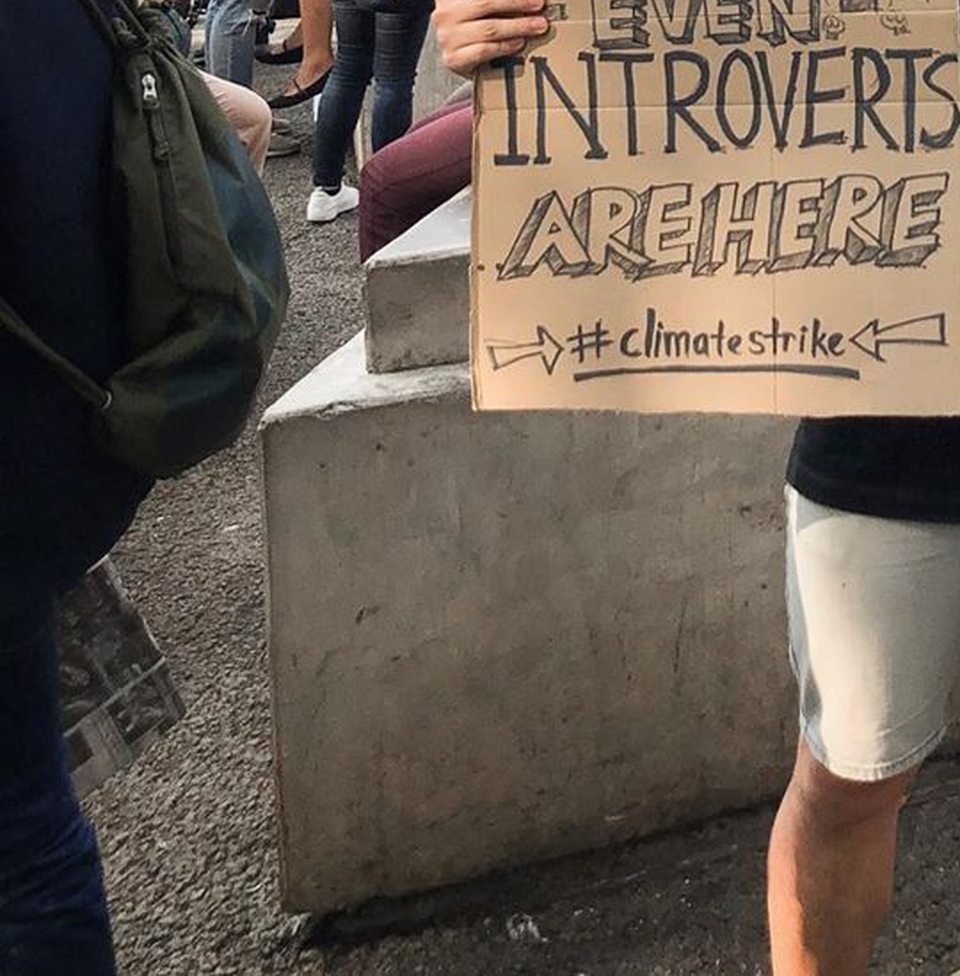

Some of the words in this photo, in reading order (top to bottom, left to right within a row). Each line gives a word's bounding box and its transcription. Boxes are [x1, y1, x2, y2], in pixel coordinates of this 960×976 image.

[497, 182, 694, 283] ARE
[691, 172, 951, 278] HERE
[566, 308, 847, 362] #climatestrike
